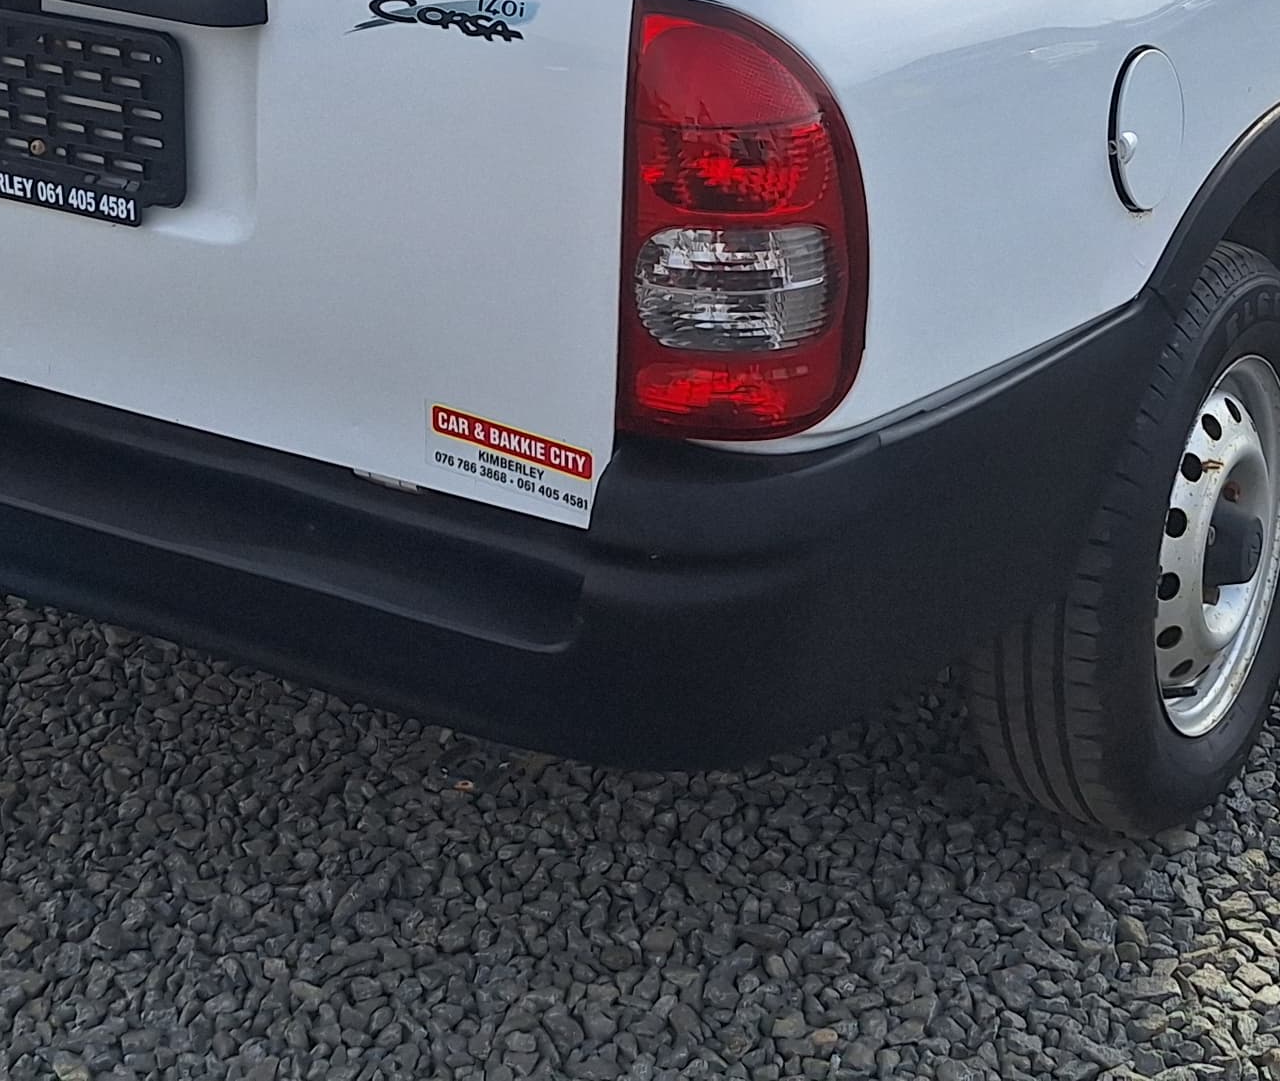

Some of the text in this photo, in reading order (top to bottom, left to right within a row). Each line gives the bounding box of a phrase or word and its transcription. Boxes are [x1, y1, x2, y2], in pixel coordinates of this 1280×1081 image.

[37, 181, 64, 205] 061
[68, 188, 96, 212] 405
[99, 195, 136, 221] 4581
[438, 411, 586, 473] CAR & BAKKIE CITY
[478, 450, 545, 481] KIMBERLEY
[435, 451, 455, 467] 076
[457, 459, 477, 474] 786
[480, 465, 507, 484] 3868
[517, 478, 535, 493] 061
[538, 485, 560, 501] 405
[563, 492, 588, 511] 4581
